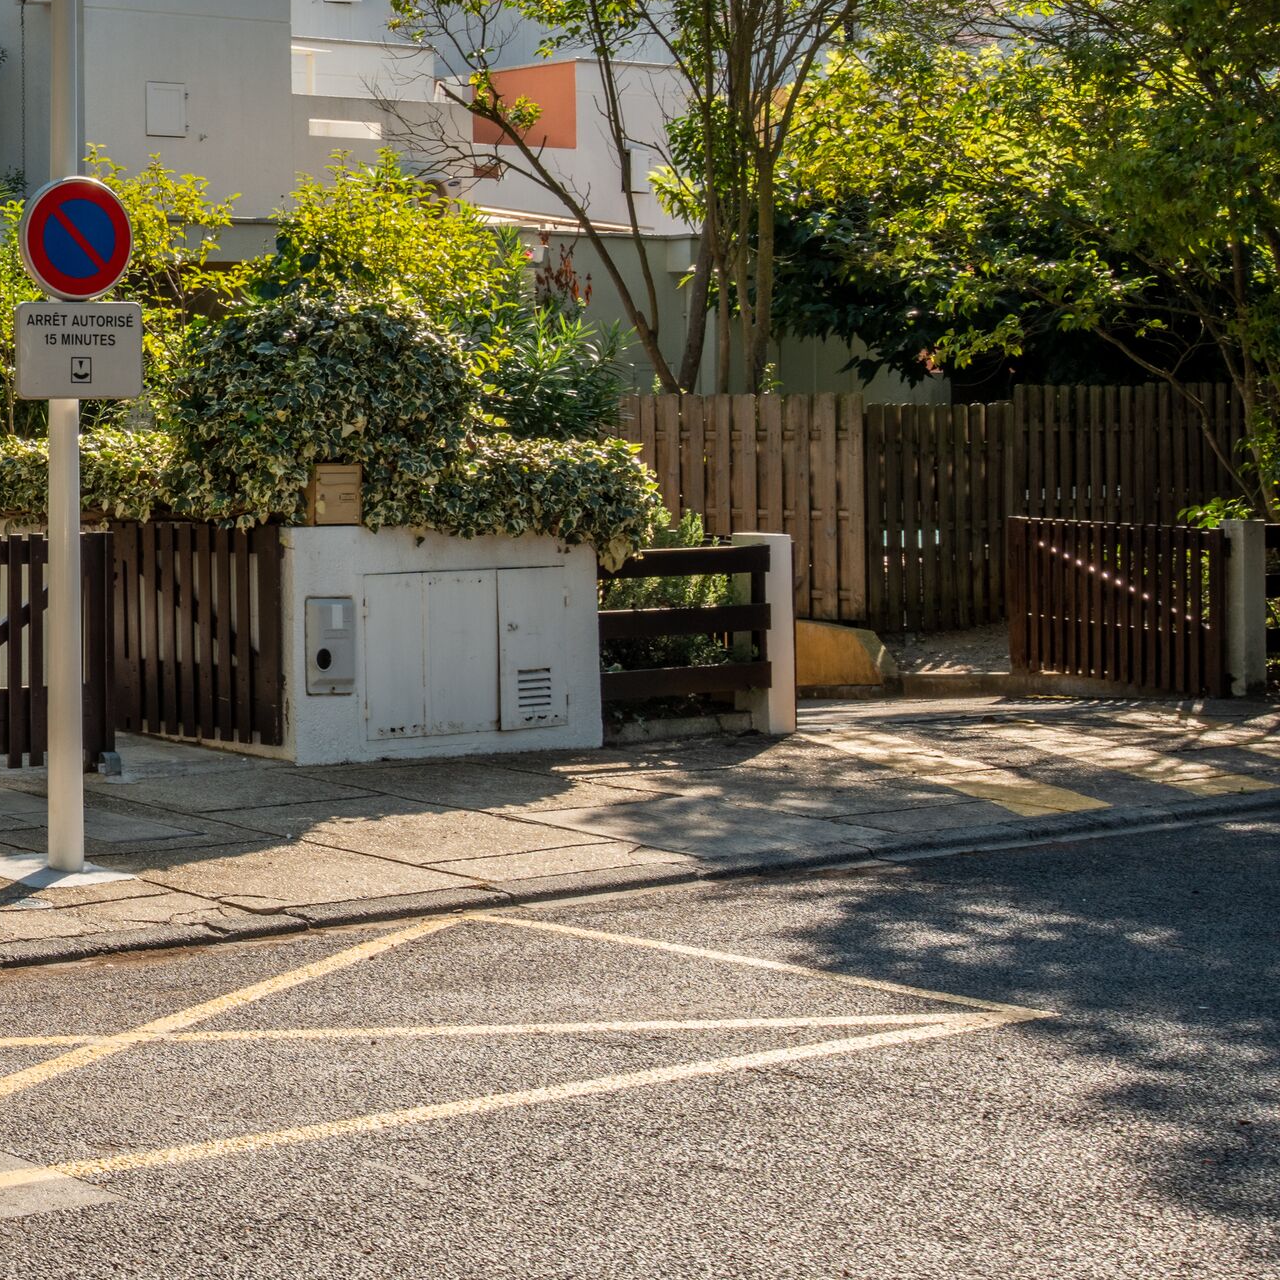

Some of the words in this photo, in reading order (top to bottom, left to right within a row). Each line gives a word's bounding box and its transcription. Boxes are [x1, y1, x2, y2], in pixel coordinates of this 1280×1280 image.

[26, 311, 68, 327] ARRÊT
[71, 313, 134, 328] AUTORISÉ
[44, 333, 57, 346] 15
[61, 333, 116, 347] MINUTES
